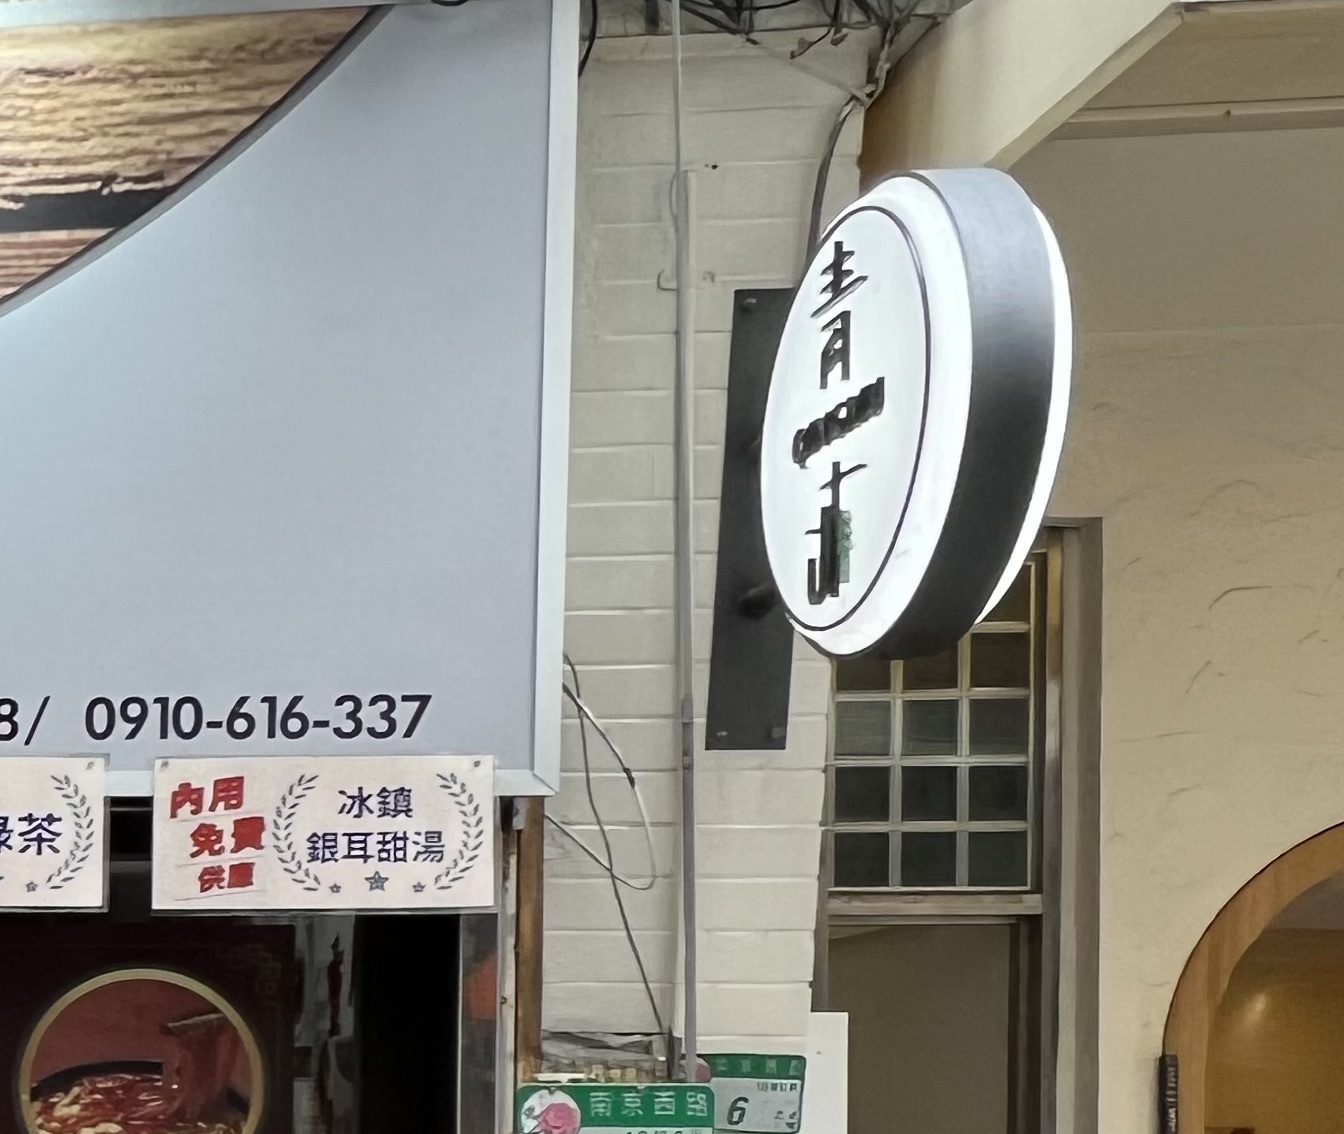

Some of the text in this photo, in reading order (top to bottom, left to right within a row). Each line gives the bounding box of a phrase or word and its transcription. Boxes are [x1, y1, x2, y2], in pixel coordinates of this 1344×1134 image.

[84, 692, 434, 742] 0910-616-337
[168, 775, 246, 819] 內用
[336, 786, 414, 820] 冰鎮
[188, 814, 267, 858] 免費
[305, 829, 447, 866] 銀耳甜湯
[726, 1096, 749, 1126] 6
